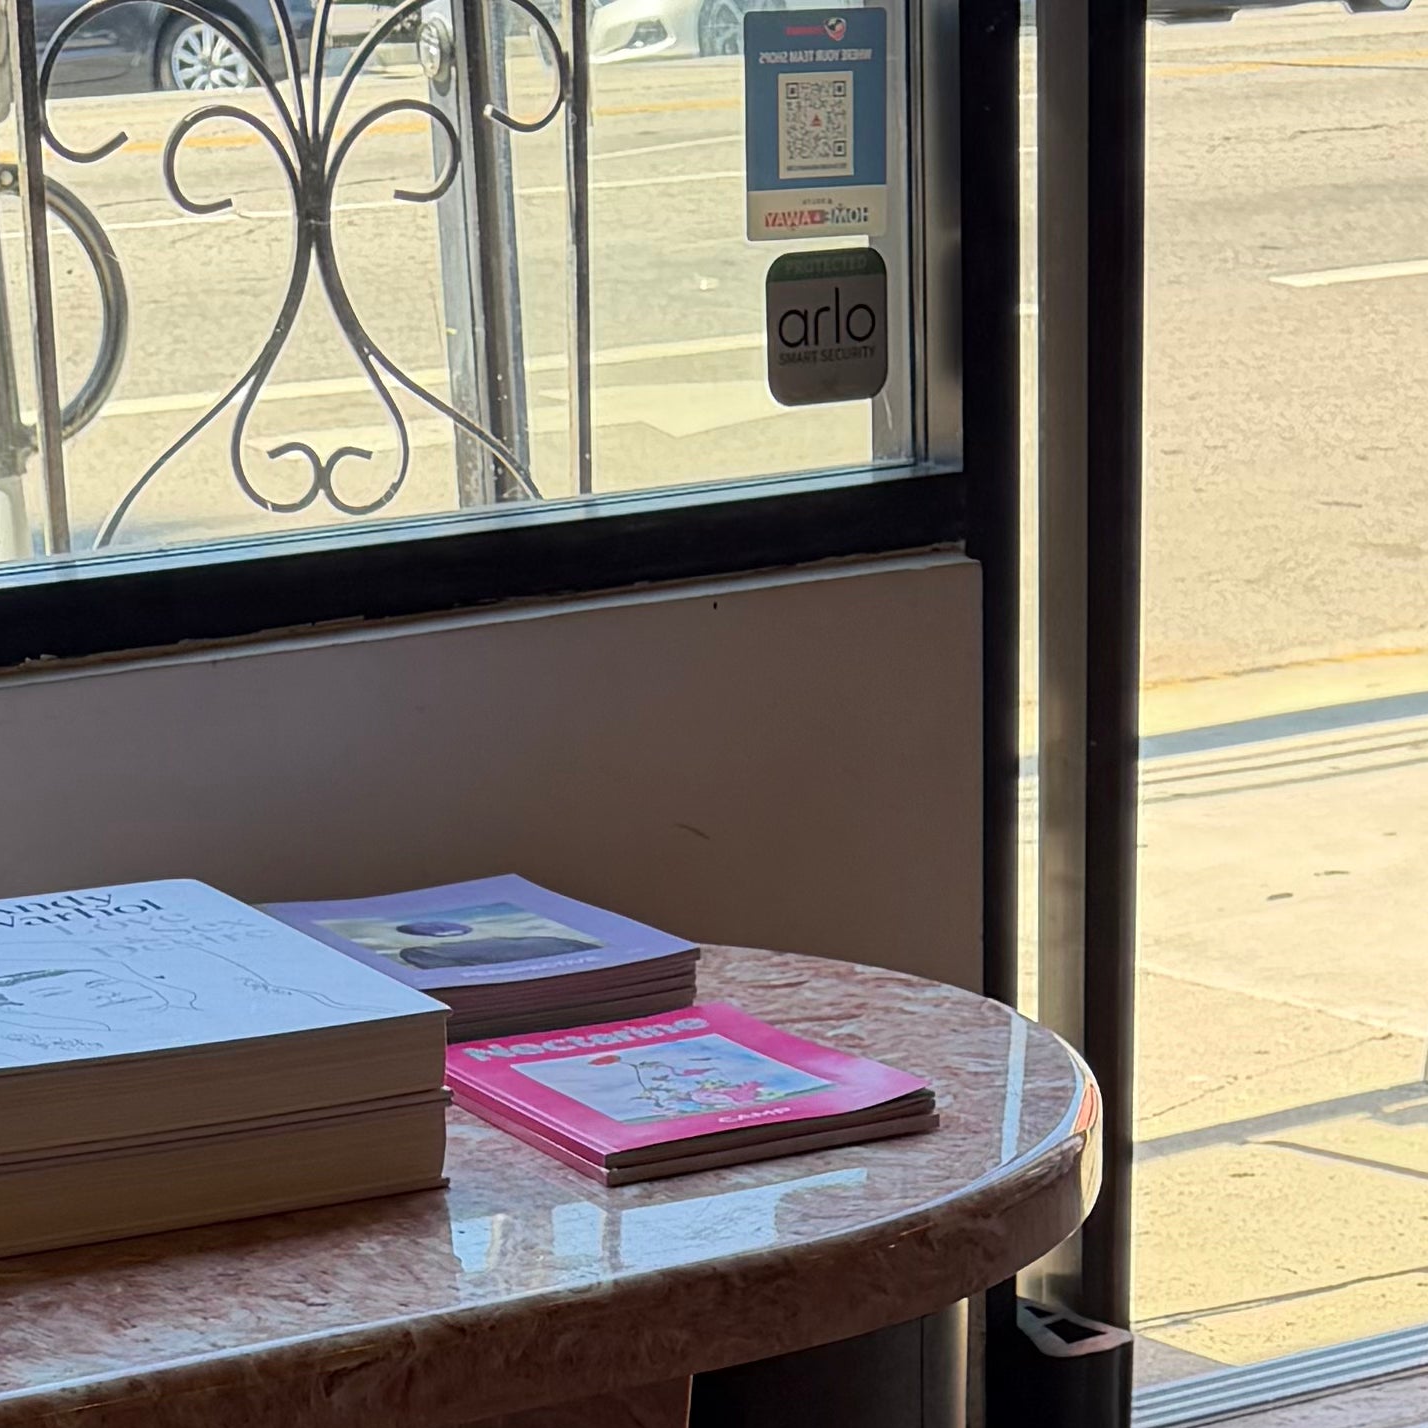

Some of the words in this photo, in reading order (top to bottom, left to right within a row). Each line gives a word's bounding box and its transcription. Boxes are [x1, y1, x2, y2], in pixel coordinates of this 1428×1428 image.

[786, 256, 867, 274] PROTECTED
[778, 286, 876, 348] arlo
[778, 351, 817, 366] SMART
[820, 345, 876, 362] SECURITY
[55, 913, 190, 936] Love
[150, 917, 259, 935] Sex
[92, 929, 272, 957] Desire
